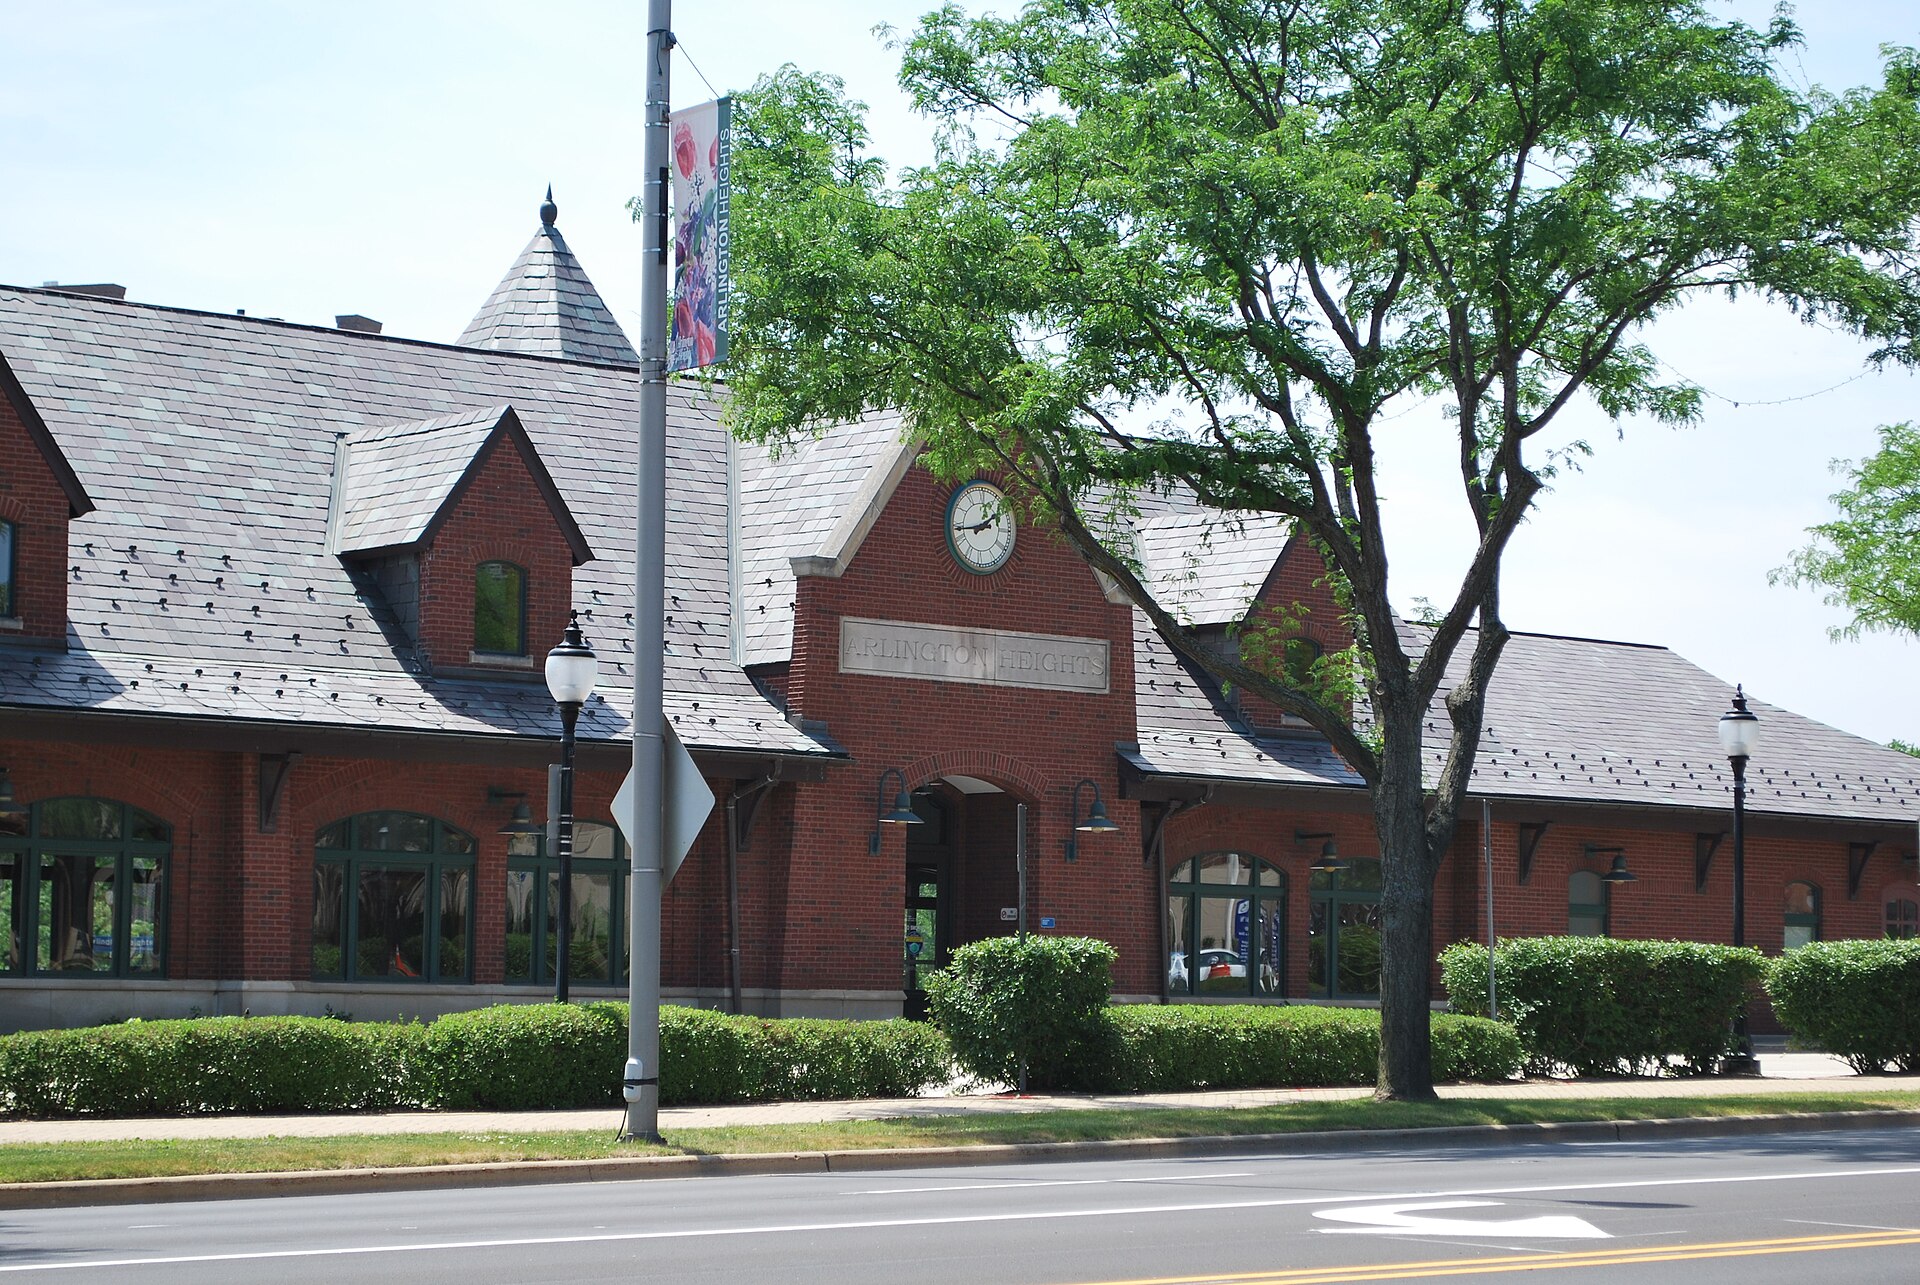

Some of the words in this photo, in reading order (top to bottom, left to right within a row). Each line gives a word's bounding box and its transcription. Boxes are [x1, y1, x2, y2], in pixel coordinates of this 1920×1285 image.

[719, 127, 730, 213] HEIGHTS
[717, 218, 728, 333] ARLINGTON
[845, 637, 989, 668] ARLINGTON
[999, 649, 1105, 676] HEIGHTS
